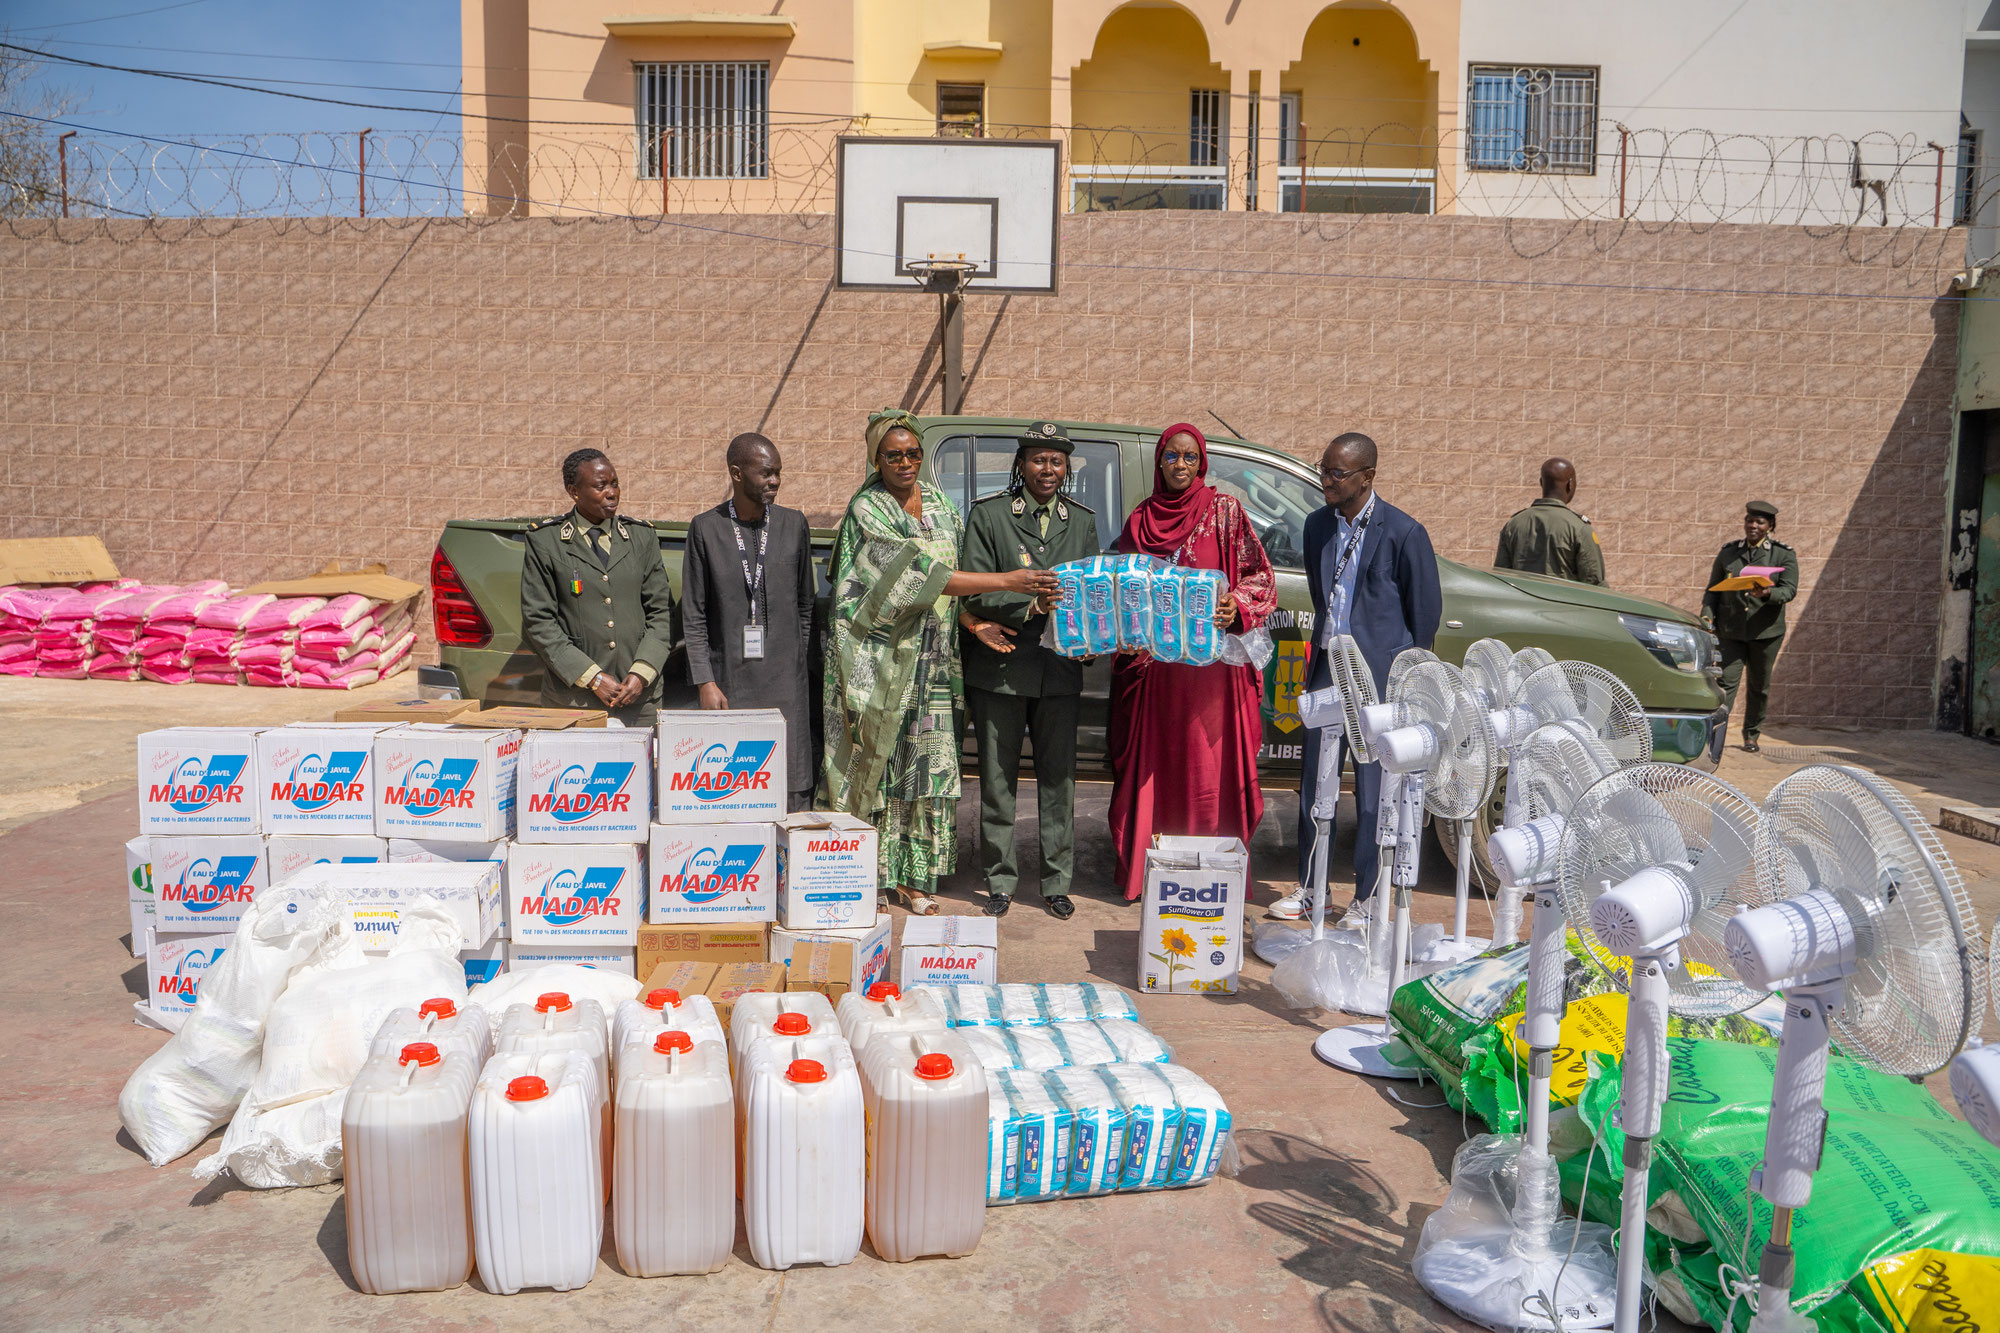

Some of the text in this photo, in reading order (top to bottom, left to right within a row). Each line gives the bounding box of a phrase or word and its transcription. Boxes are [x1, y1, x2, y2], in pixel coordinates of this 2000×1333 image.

[1065, 579, 1078, 608] Lilas
[1095, 583, 1107, 611] Lilas
[1128, 582, 1140, 609] Lilas
[1162, 584, 1174, 613] Lilas
[1196, 587, 1208, 616] Lilas
[302, 766, 318, 774] EAU
[330, 766, 351, 774] JAVEL
[706, 756, 722, 764] EAU
[415, 772, 430, 780] EAU
[441, 773, 463, 781] JAVEL
[593, 777, 616, 785] JAVEL
[670, 771, 771, 791] MADAR
[148, 784, 244, 803] MADAR
[270, 782, 365, 802] MADAR
[384, 786, 475, 809] MADAR
[528, 793, 631, 813] MADAR
[456, 821, 482, 829] BACTERIES
[807, 839, 860, 853] MADAR
[724, 859, 746, 867] JAVEL
[161, 883, 255, 903] MADAR
[659, 873, 760, 893] MADAR
[1159, 880, 1228, 903] Padi
[520, 896, 621, 916] MADAR
[1168, 906, 1216, 917] Sunflower Oil
[353, 920, 402, 935] Amira
[861, 945, 889, 984] MADAR
[920, 957, 977, 970] MADAR
[1189, 978, 1233, 993] 4x5L
[1419, 1003, 1434, 1020] SAC
[1828, 1133, 1850, 1155] RUE
[1847, 1131, 1912, 1190] IMPORTATEUR
